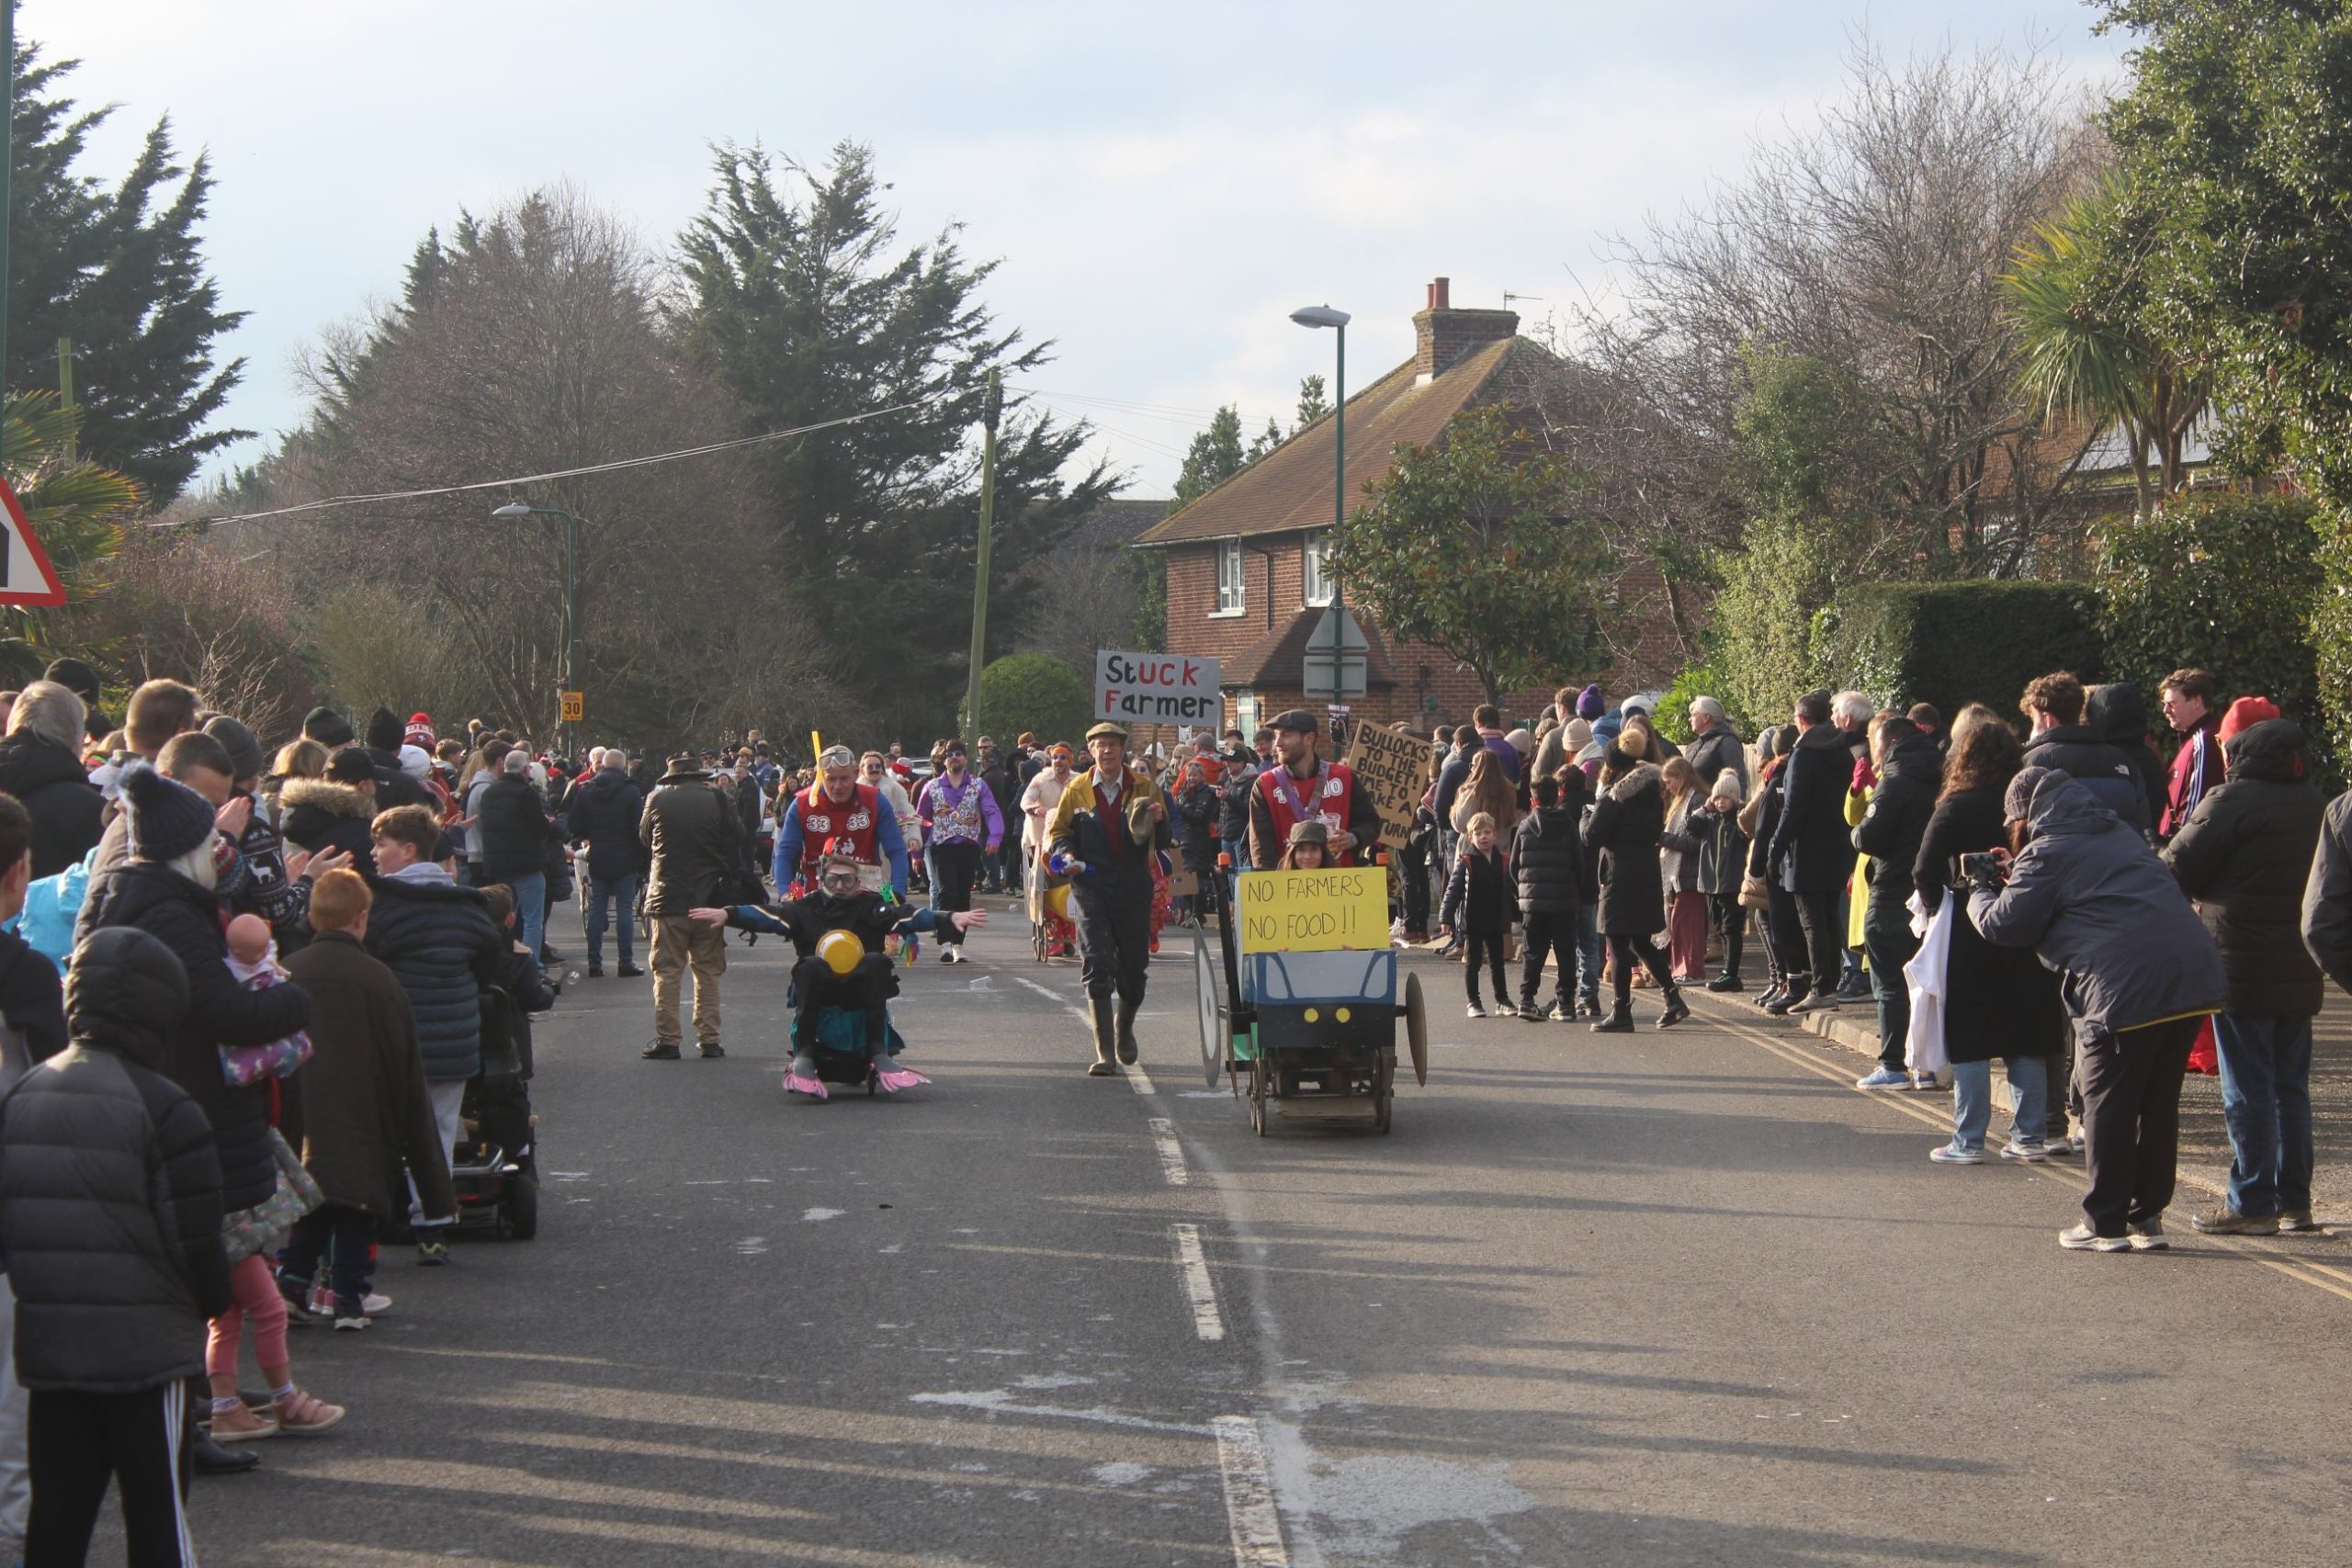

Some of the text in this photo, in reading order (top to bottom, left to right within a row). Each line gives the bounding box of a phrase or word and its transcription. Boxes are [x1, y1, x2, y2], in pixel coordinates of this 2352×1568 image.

[565, 702, 581, 715] 30
[1105, 690, 1215, 717] Farmer
[1359, 724, 1430, 763] BULLOCKS
[1365, 745, 1418, 773] TO THE
[1357, 757, 1420, 790] BUDGET!
[1369, 790, 1412, 817] AKE A
[1388, 783, 1408, 800] TO
[808, 816, 830, 832] 33
[846, 813, 870, 831] 33
[1248, 874, 1364, 902] NO FARMERS
[1249, 915, 1278, 941] NO
